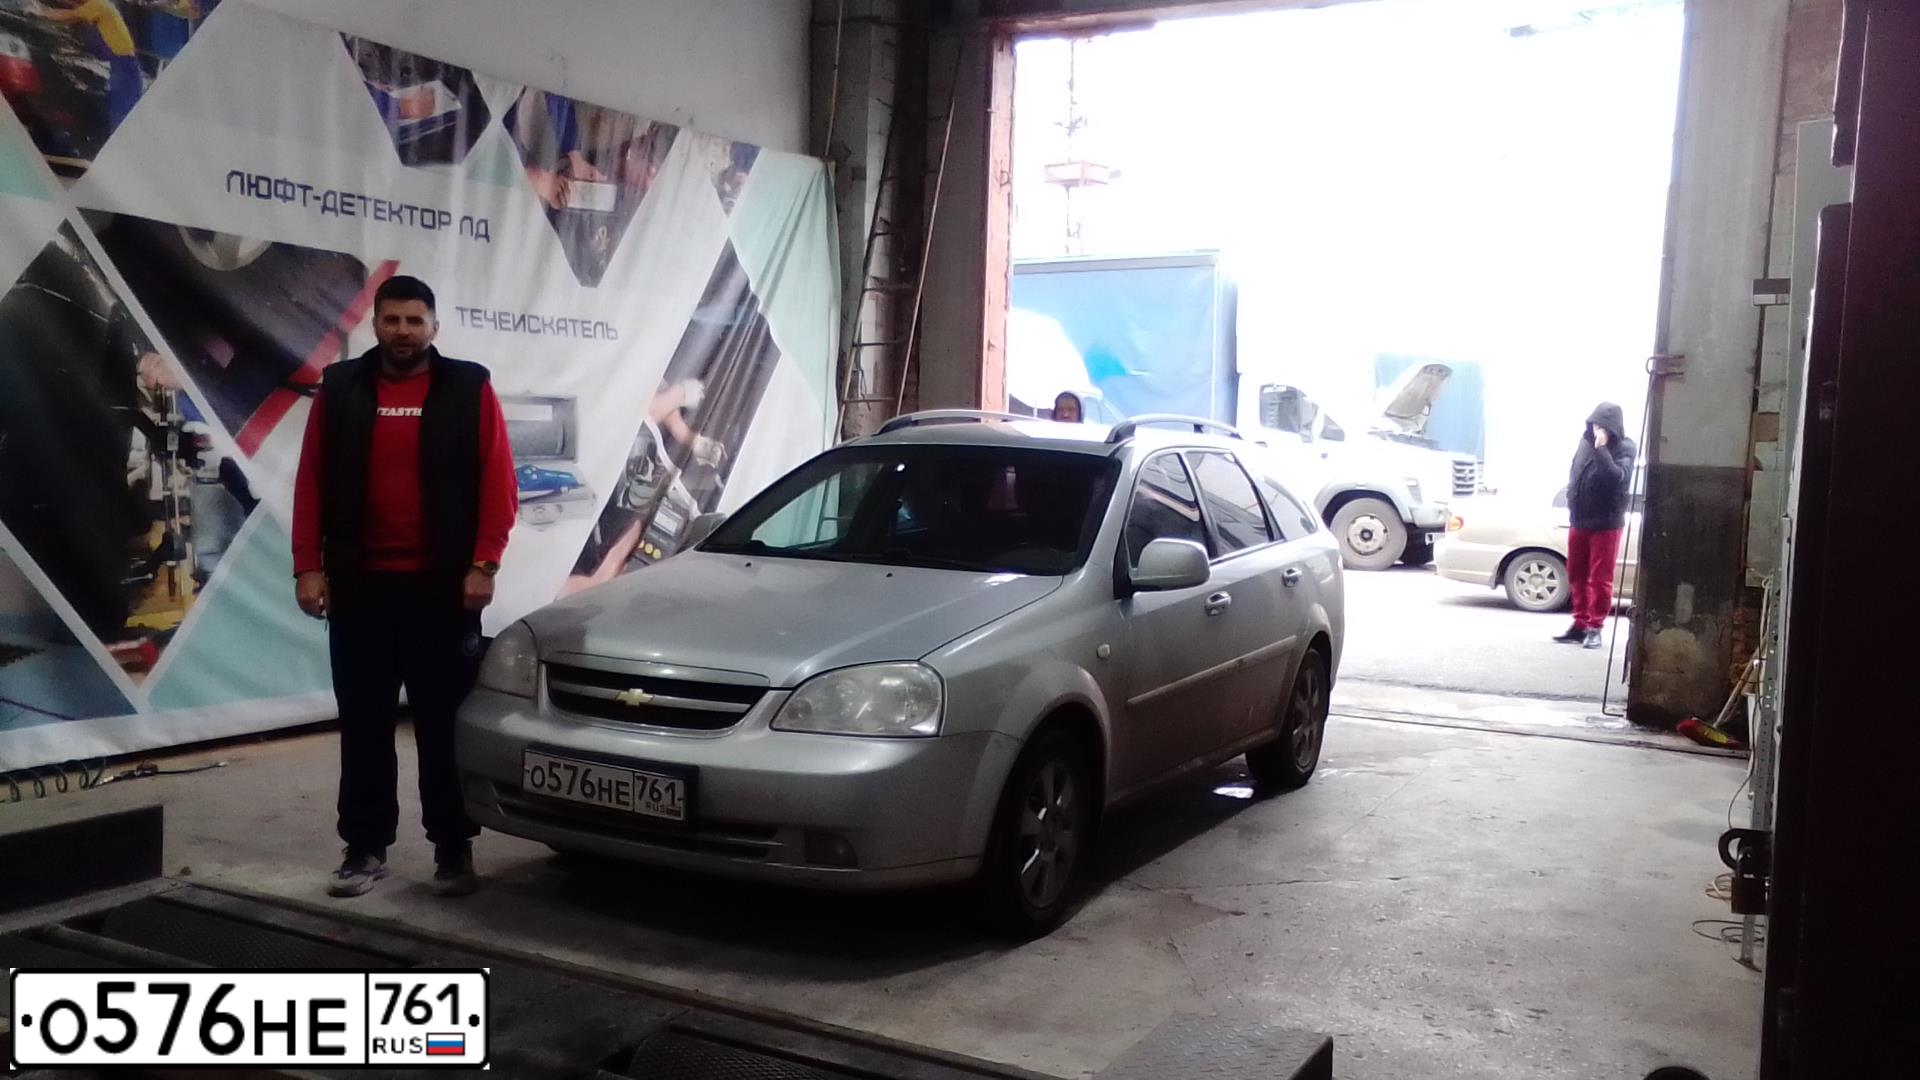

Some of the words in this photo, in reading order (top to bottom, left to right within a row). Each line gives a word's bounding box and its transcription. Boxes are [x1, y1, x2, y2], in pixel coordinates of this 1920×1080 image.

[225, 170, 452, 231] ЛЮФТ-ДЕТЕКТОР
[459, 215, 491, 243] ЛД
[635, 774, 677, 807] 761
